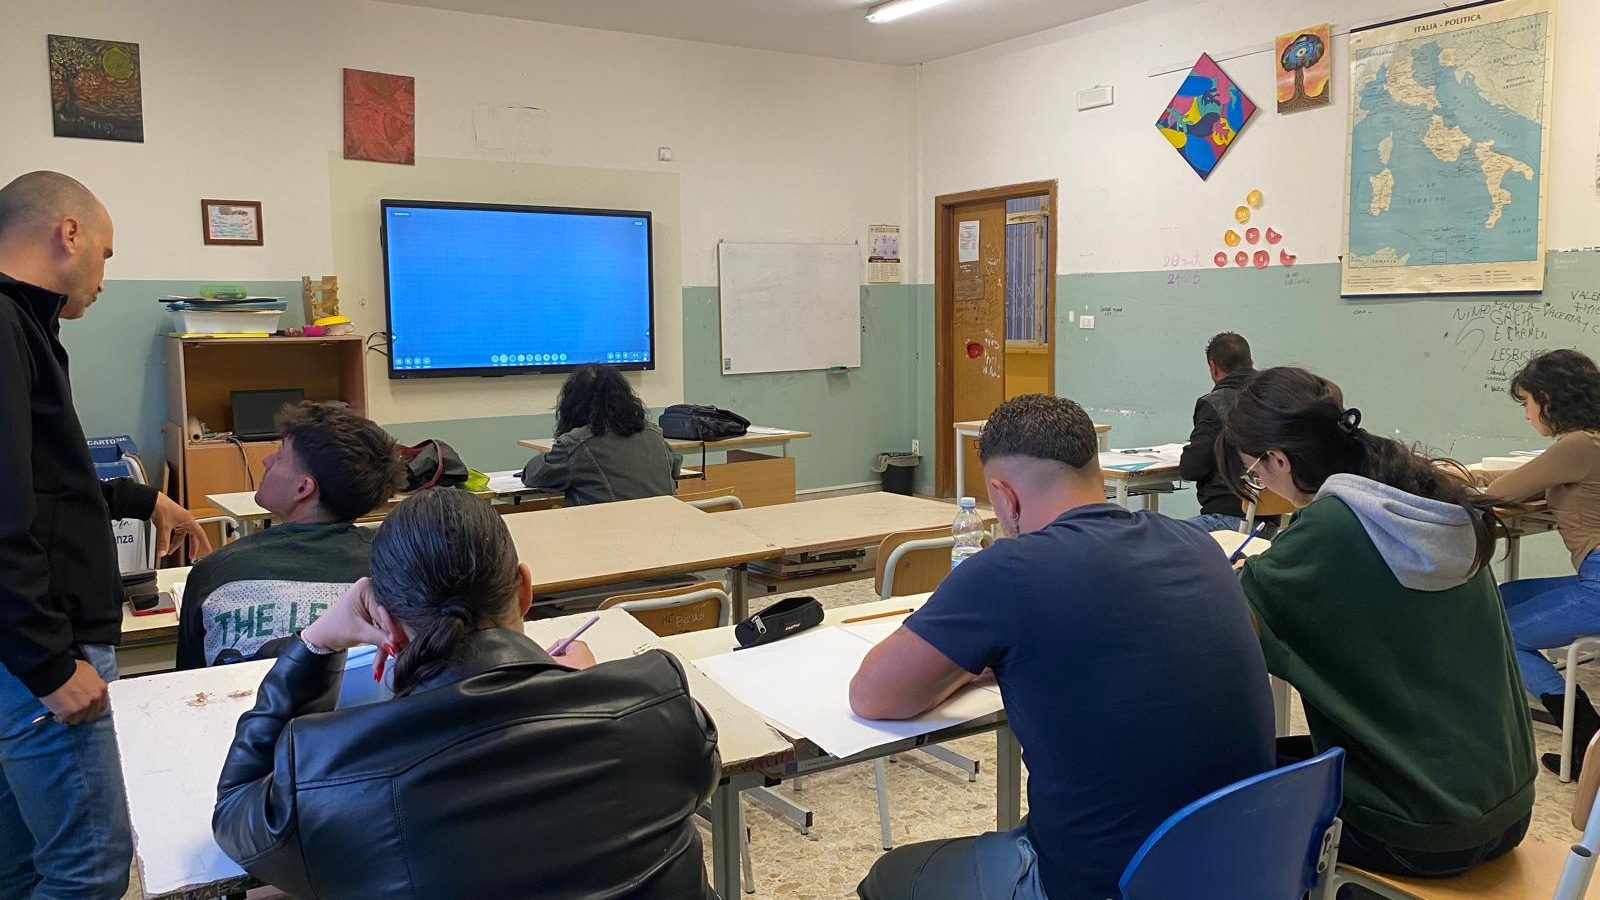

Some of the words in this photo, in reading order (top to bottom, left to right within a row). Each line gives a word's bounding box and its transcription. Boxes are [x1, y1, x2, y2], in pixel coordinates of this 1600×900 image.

[1414, 23, 1438, 33] ITALIA
[1444, 14, 1482, 27] POLITICA
[116, 534, 134, 544] nza
[214, 602, 277, 646] THE
[288, 602, 329, 634] LE
